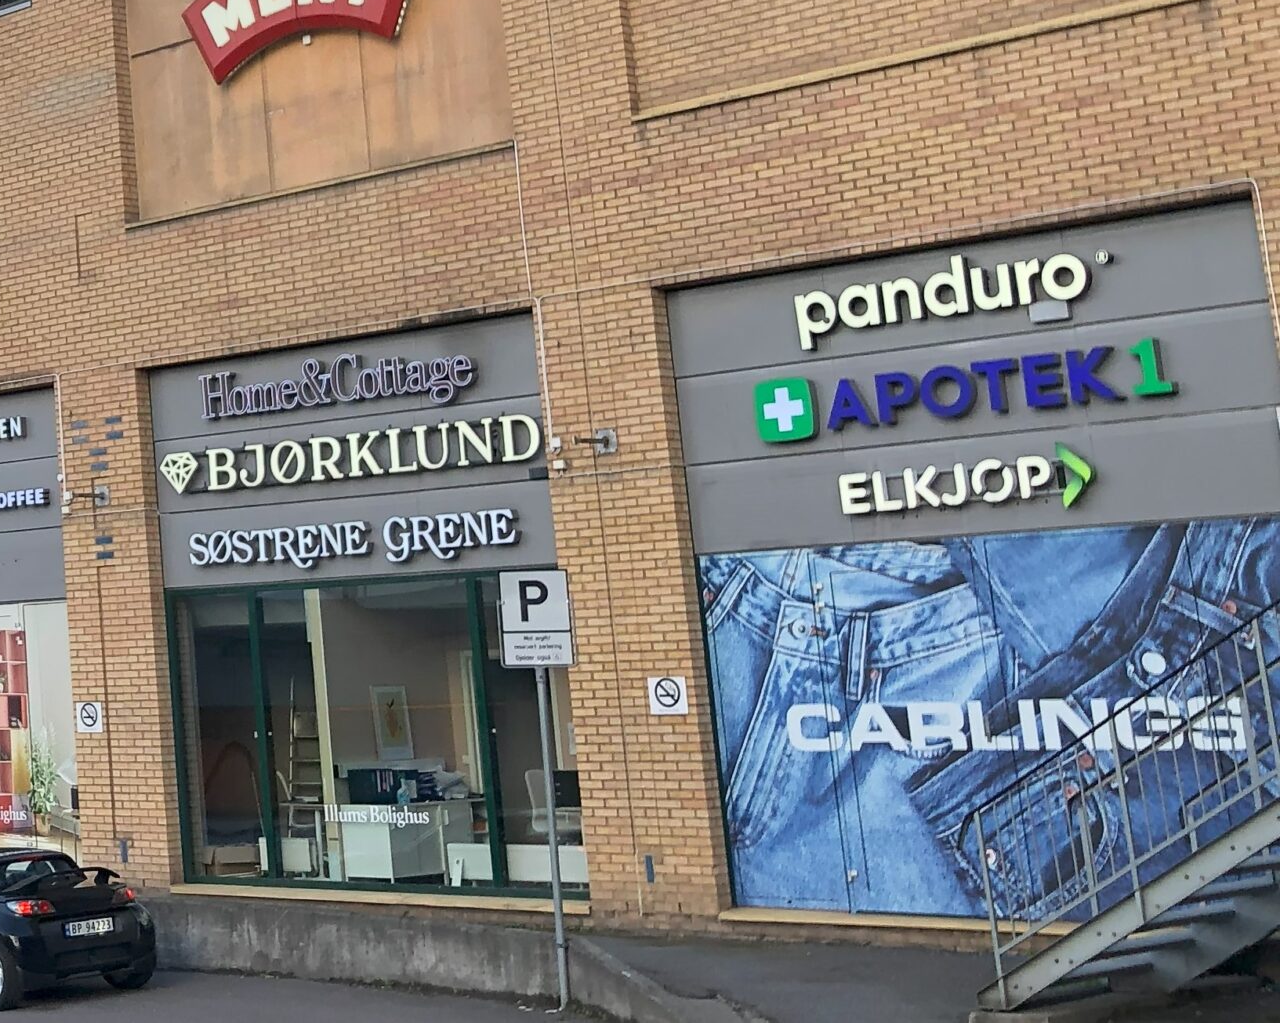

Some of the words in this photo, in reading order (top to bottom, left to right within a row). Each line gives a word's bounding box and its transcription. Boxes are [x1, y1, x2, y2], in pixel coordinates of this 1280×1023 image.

[827, 345, 1126, 431] APOTEK
[1128, 336, 1178, 397] 1
[205, 413, 541, 491] BJØRKLUND
[189, 520, 369, 569] SØSTRENE
[382, 508, 517, 563] GRENE
[519, 580, 548, 622] P
[786, 696, 1252, 753] CARLINGS
[324, 803, 368, 823] Illums
[369, 805, 430, 829] Bolighus
